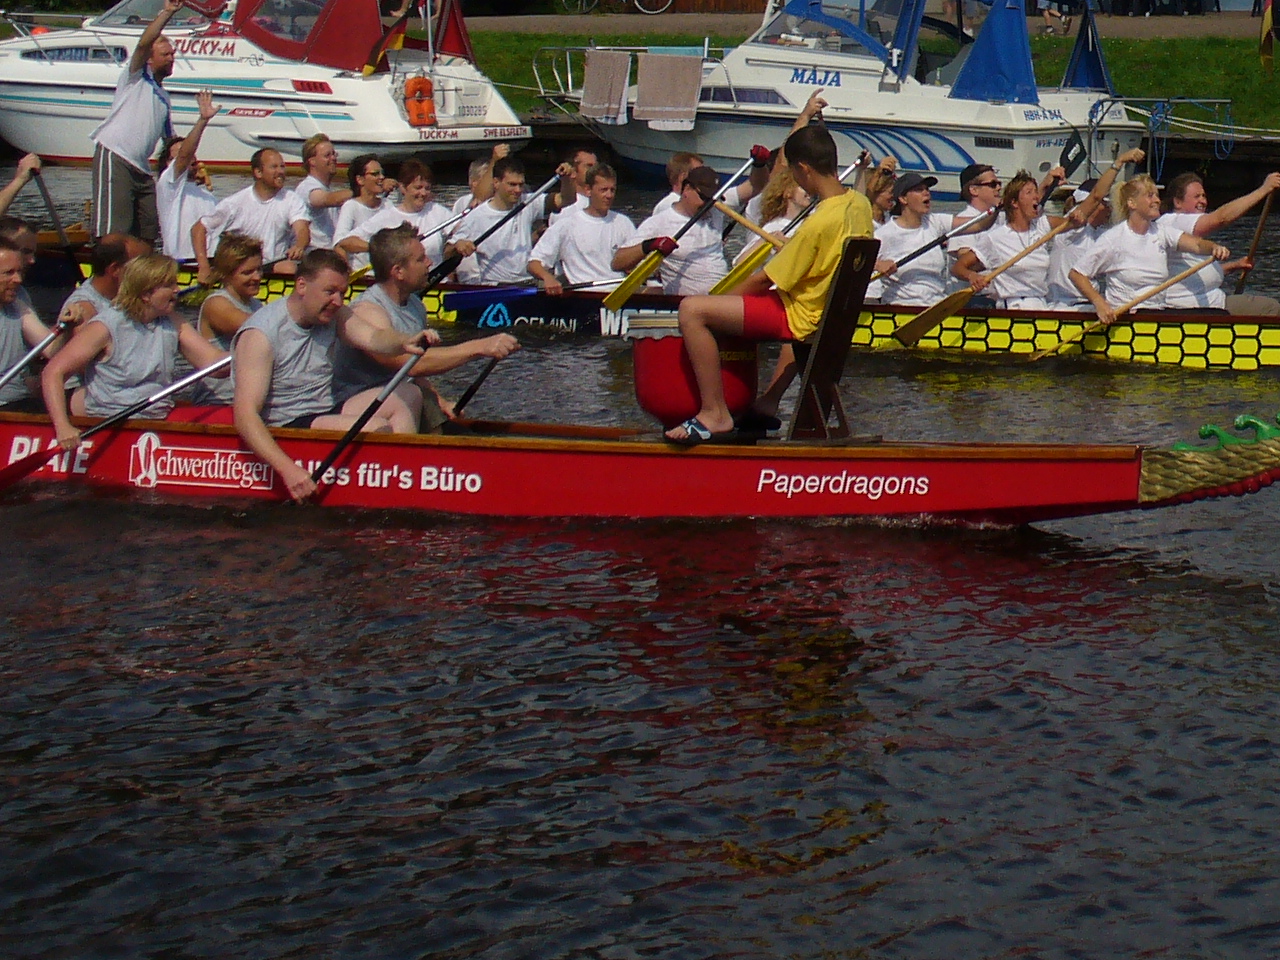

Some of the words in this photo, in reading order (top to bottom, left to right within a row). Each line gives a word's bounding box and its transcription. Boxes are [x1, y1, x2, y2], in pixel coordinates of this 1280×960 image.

[790, 68, 841, 87] MAJA
[294, 460, 350, 486] les
[356, 463, 412, 489] für's
[420, 466, 482, 492] Büro
[757, 469, 929, 500] Paperdragons
